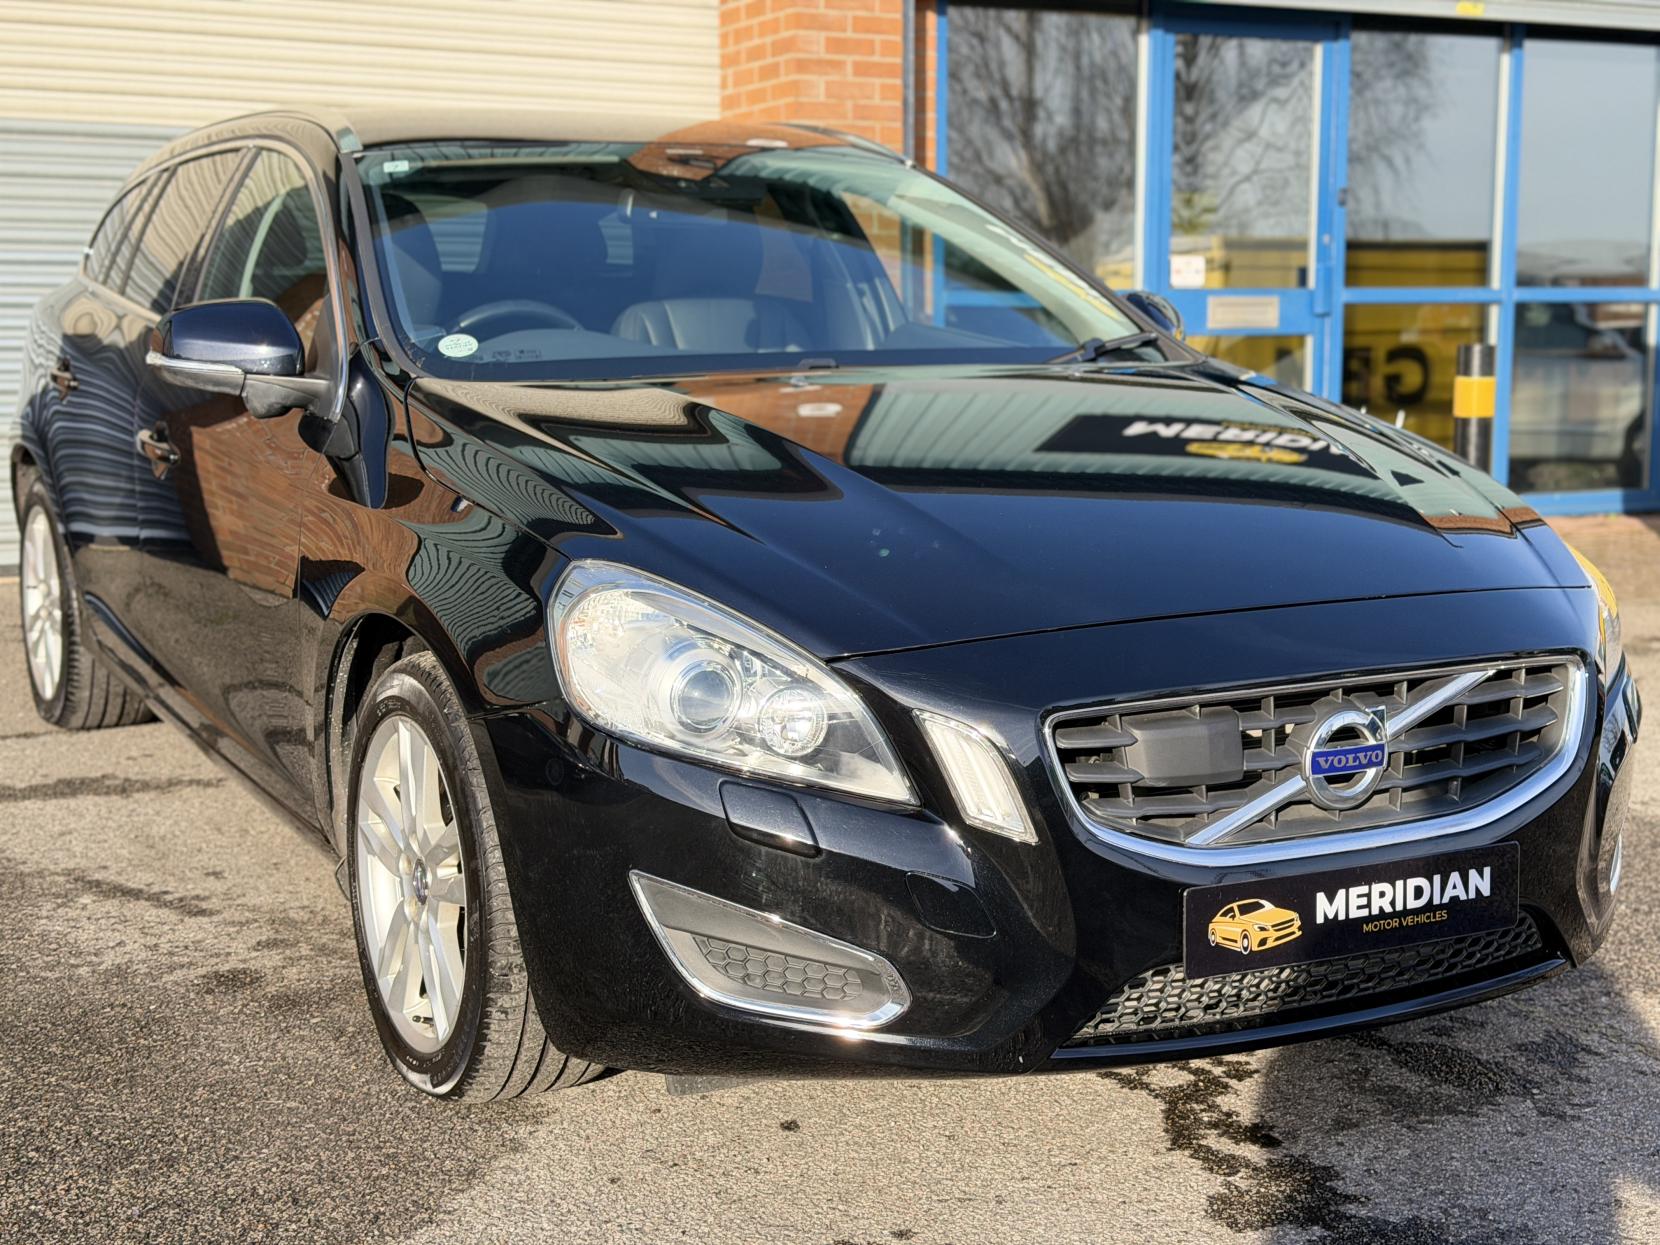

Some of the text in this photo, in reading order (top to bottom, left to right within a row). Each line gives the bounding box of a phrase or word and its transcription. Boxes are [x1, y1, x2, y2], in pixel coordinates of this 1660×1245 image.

[1316, 750, 1383, 769] VOLVO
[1315, 866, 1492, 924] MERIDIAN
[1363, 910, 1449, 934] MOTOR VEHICLES
